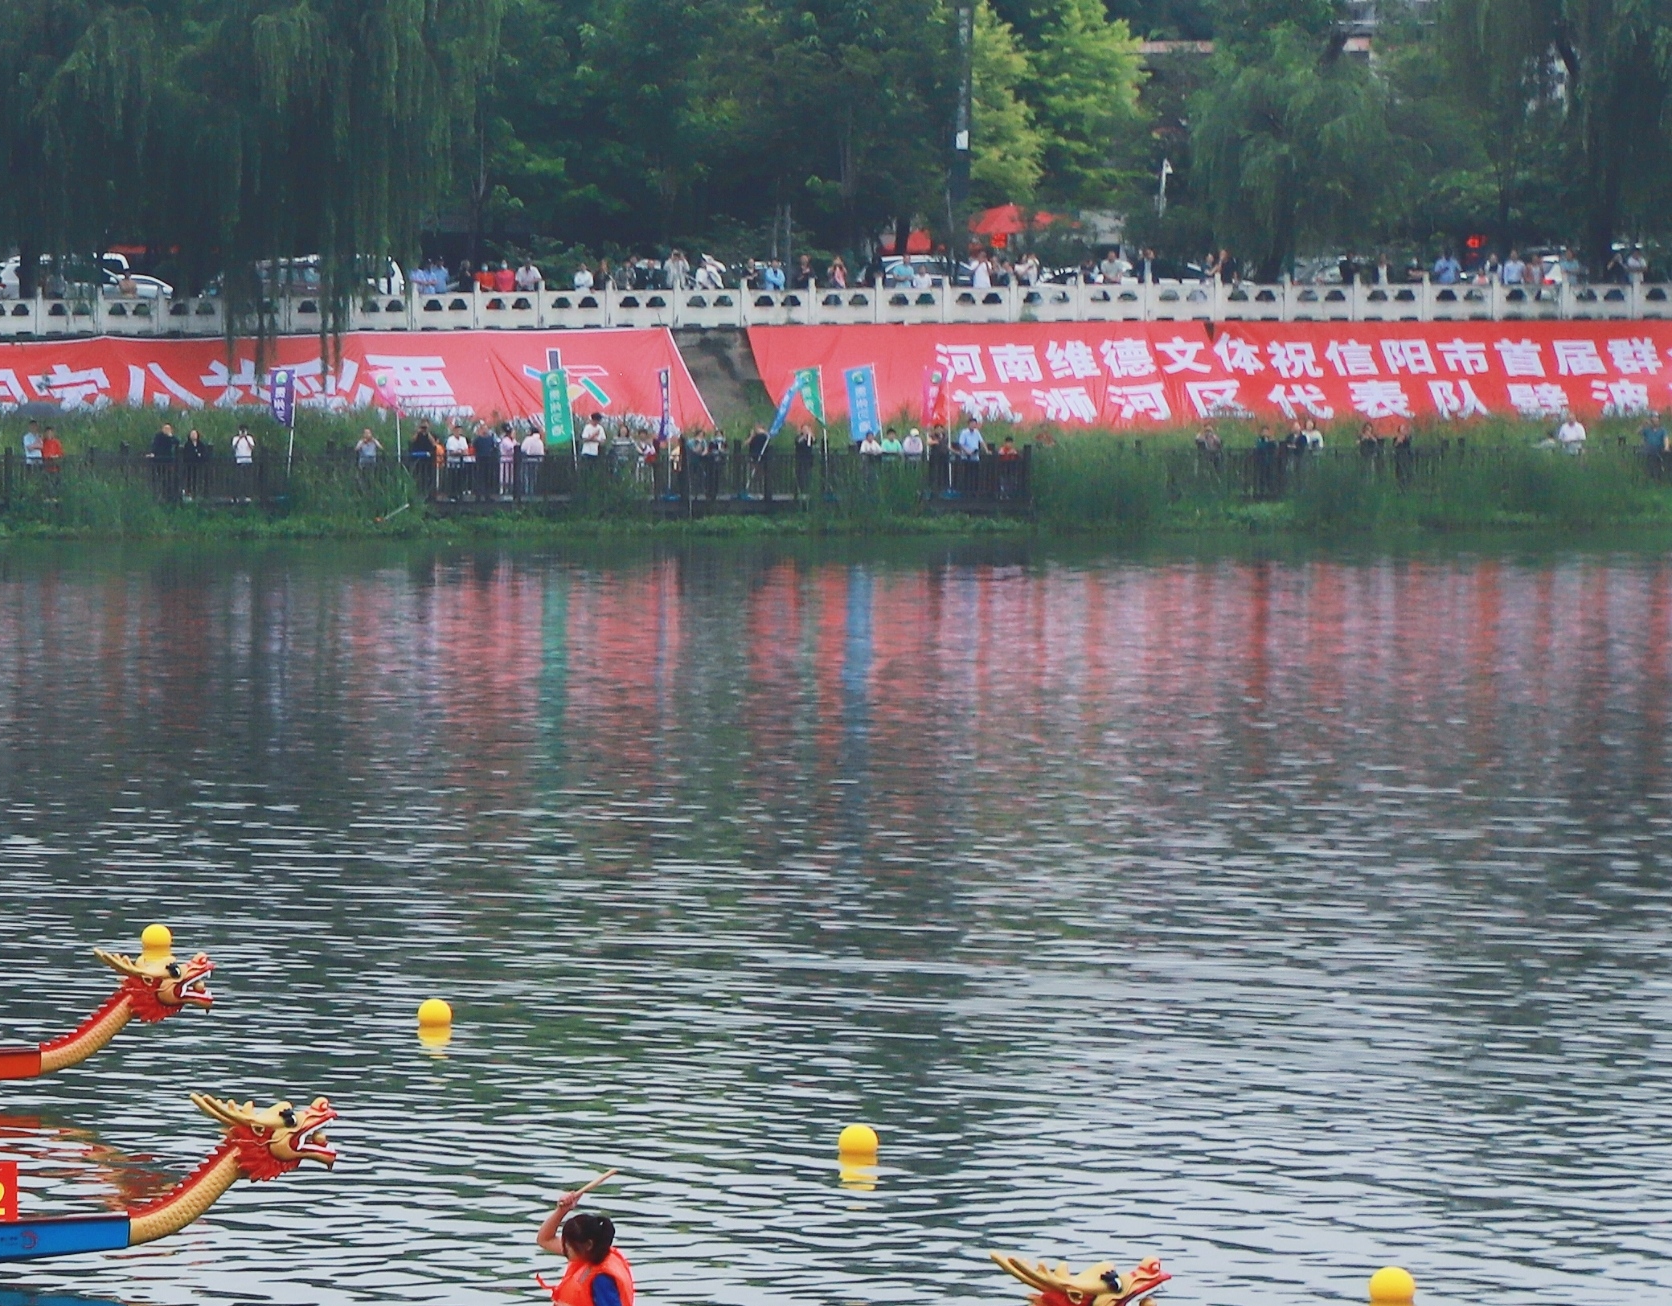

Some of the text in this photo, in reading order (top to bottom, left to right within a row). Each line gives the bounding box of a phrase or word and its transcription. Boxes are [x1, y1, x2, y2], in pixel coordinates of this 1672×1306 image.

[935, 333, 1672, 383] 河南维德文体祝信阳市首届群
[953, 379, 1672, 423] 祝浉河区代表队劈波
